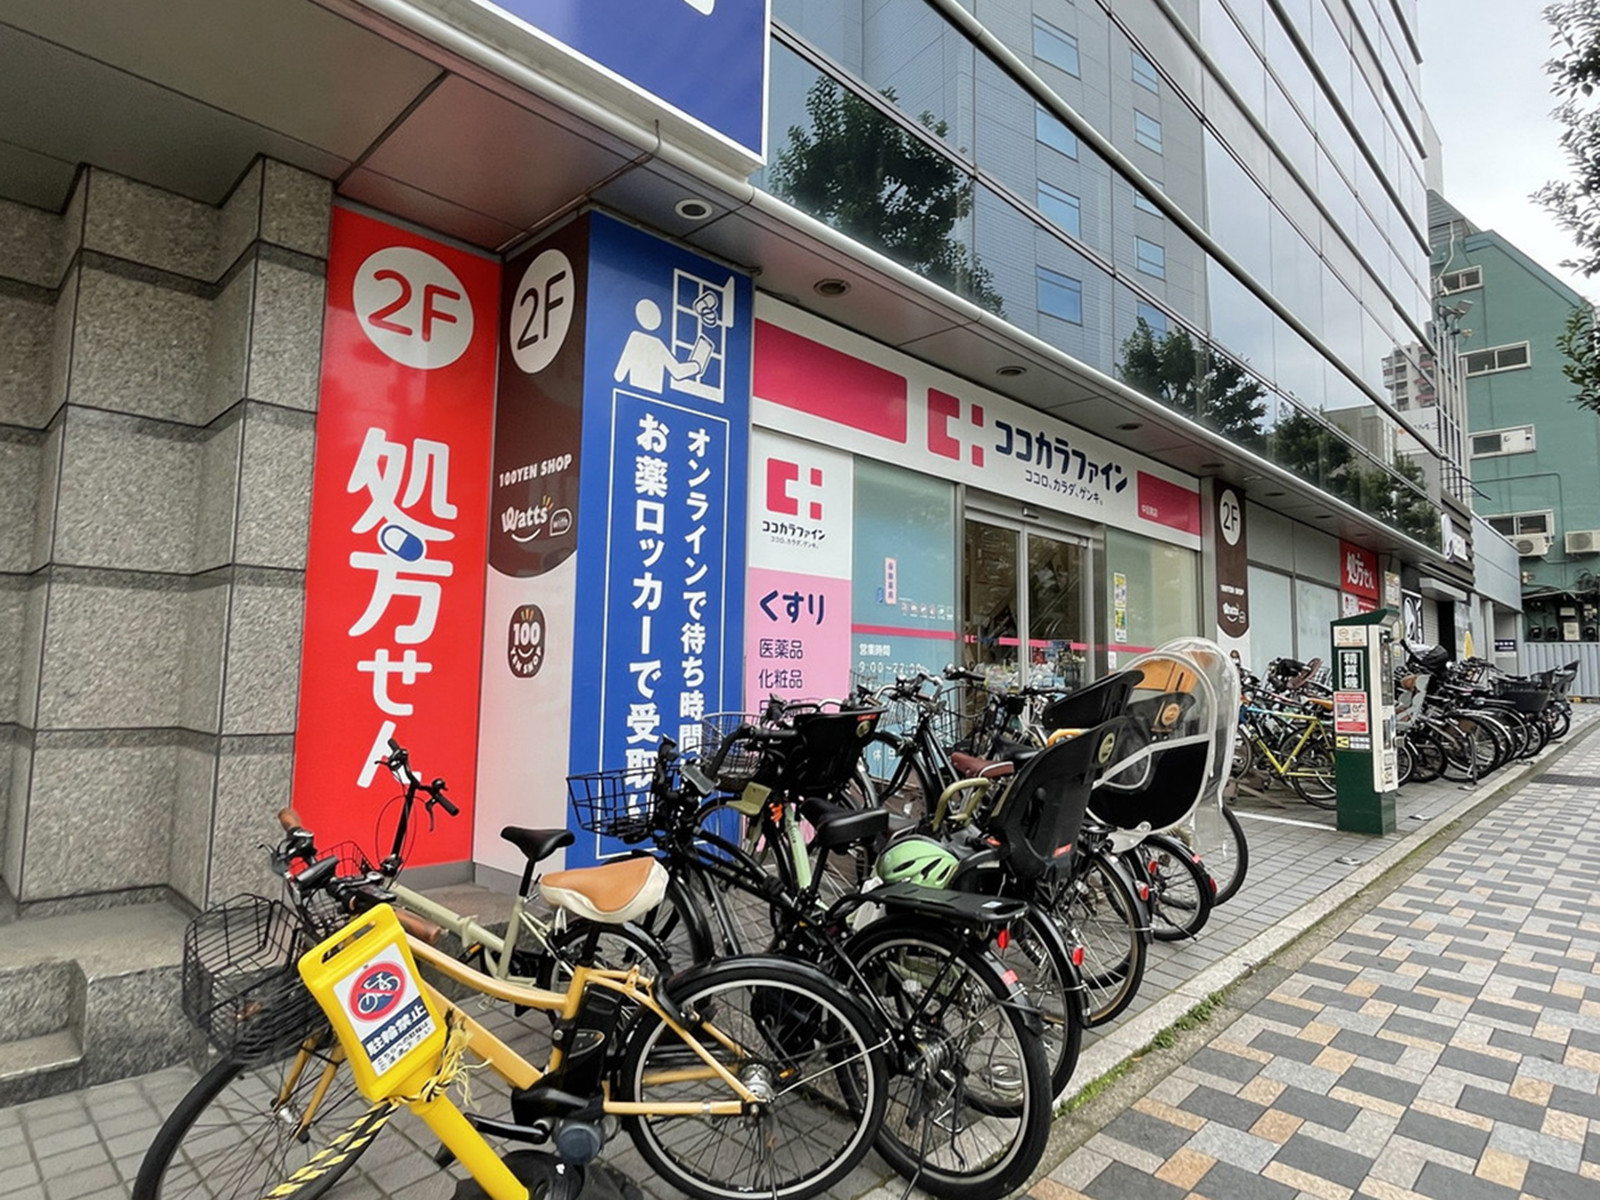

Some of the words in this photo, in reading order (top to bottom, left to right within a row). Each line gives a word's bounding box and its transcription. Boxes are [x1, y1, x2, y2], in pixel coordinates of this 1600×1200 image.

[367, 268, 461, 343] 2F
[516, 270, 567, 351] 2F
[499, 463, 538, 488] 100YEN
[540, 453, 573, 477] SHOP
[994, 419, 1129, 494] ココカラファイン
[501, 506, 549, 532] Watts
[762, 520, 826, 541] ココカラファイン
[1222, 501, 1238, 532] 2F
[346, 426, 459, 789] 処方せん
[759, 589, 825, 626] くすり
[512, 621, 541, 646] 100
[759, 638, 803, 660] 医薬品
[758, 668, 803, 690] 化粧品
[365, 1004, 427, 1057] 駐輪禁止
